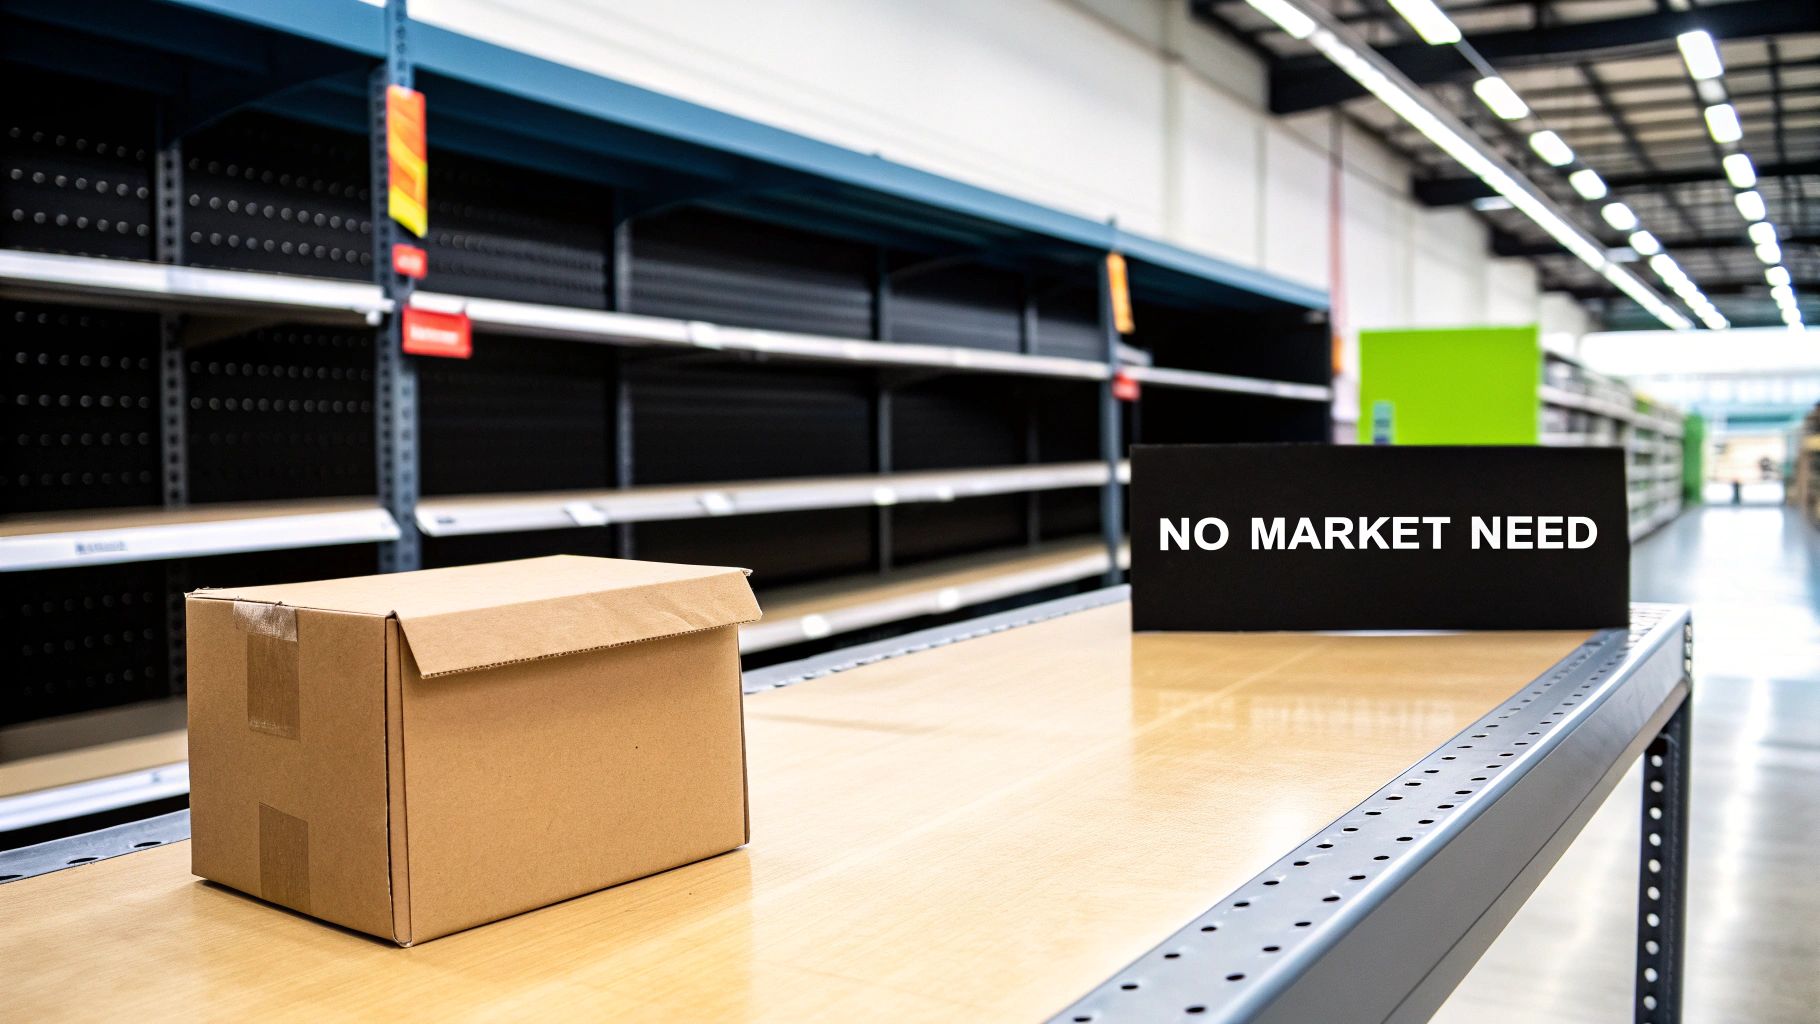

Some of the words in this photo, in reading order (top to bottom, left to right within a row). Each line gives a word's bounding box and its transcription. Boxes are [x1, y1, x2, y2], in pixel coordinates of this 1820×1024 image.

[1159, 516, 1230, 550] NO
[1251, 516, 1451, 550] MARKET
[1471, 515, 1598, 549] NEED
